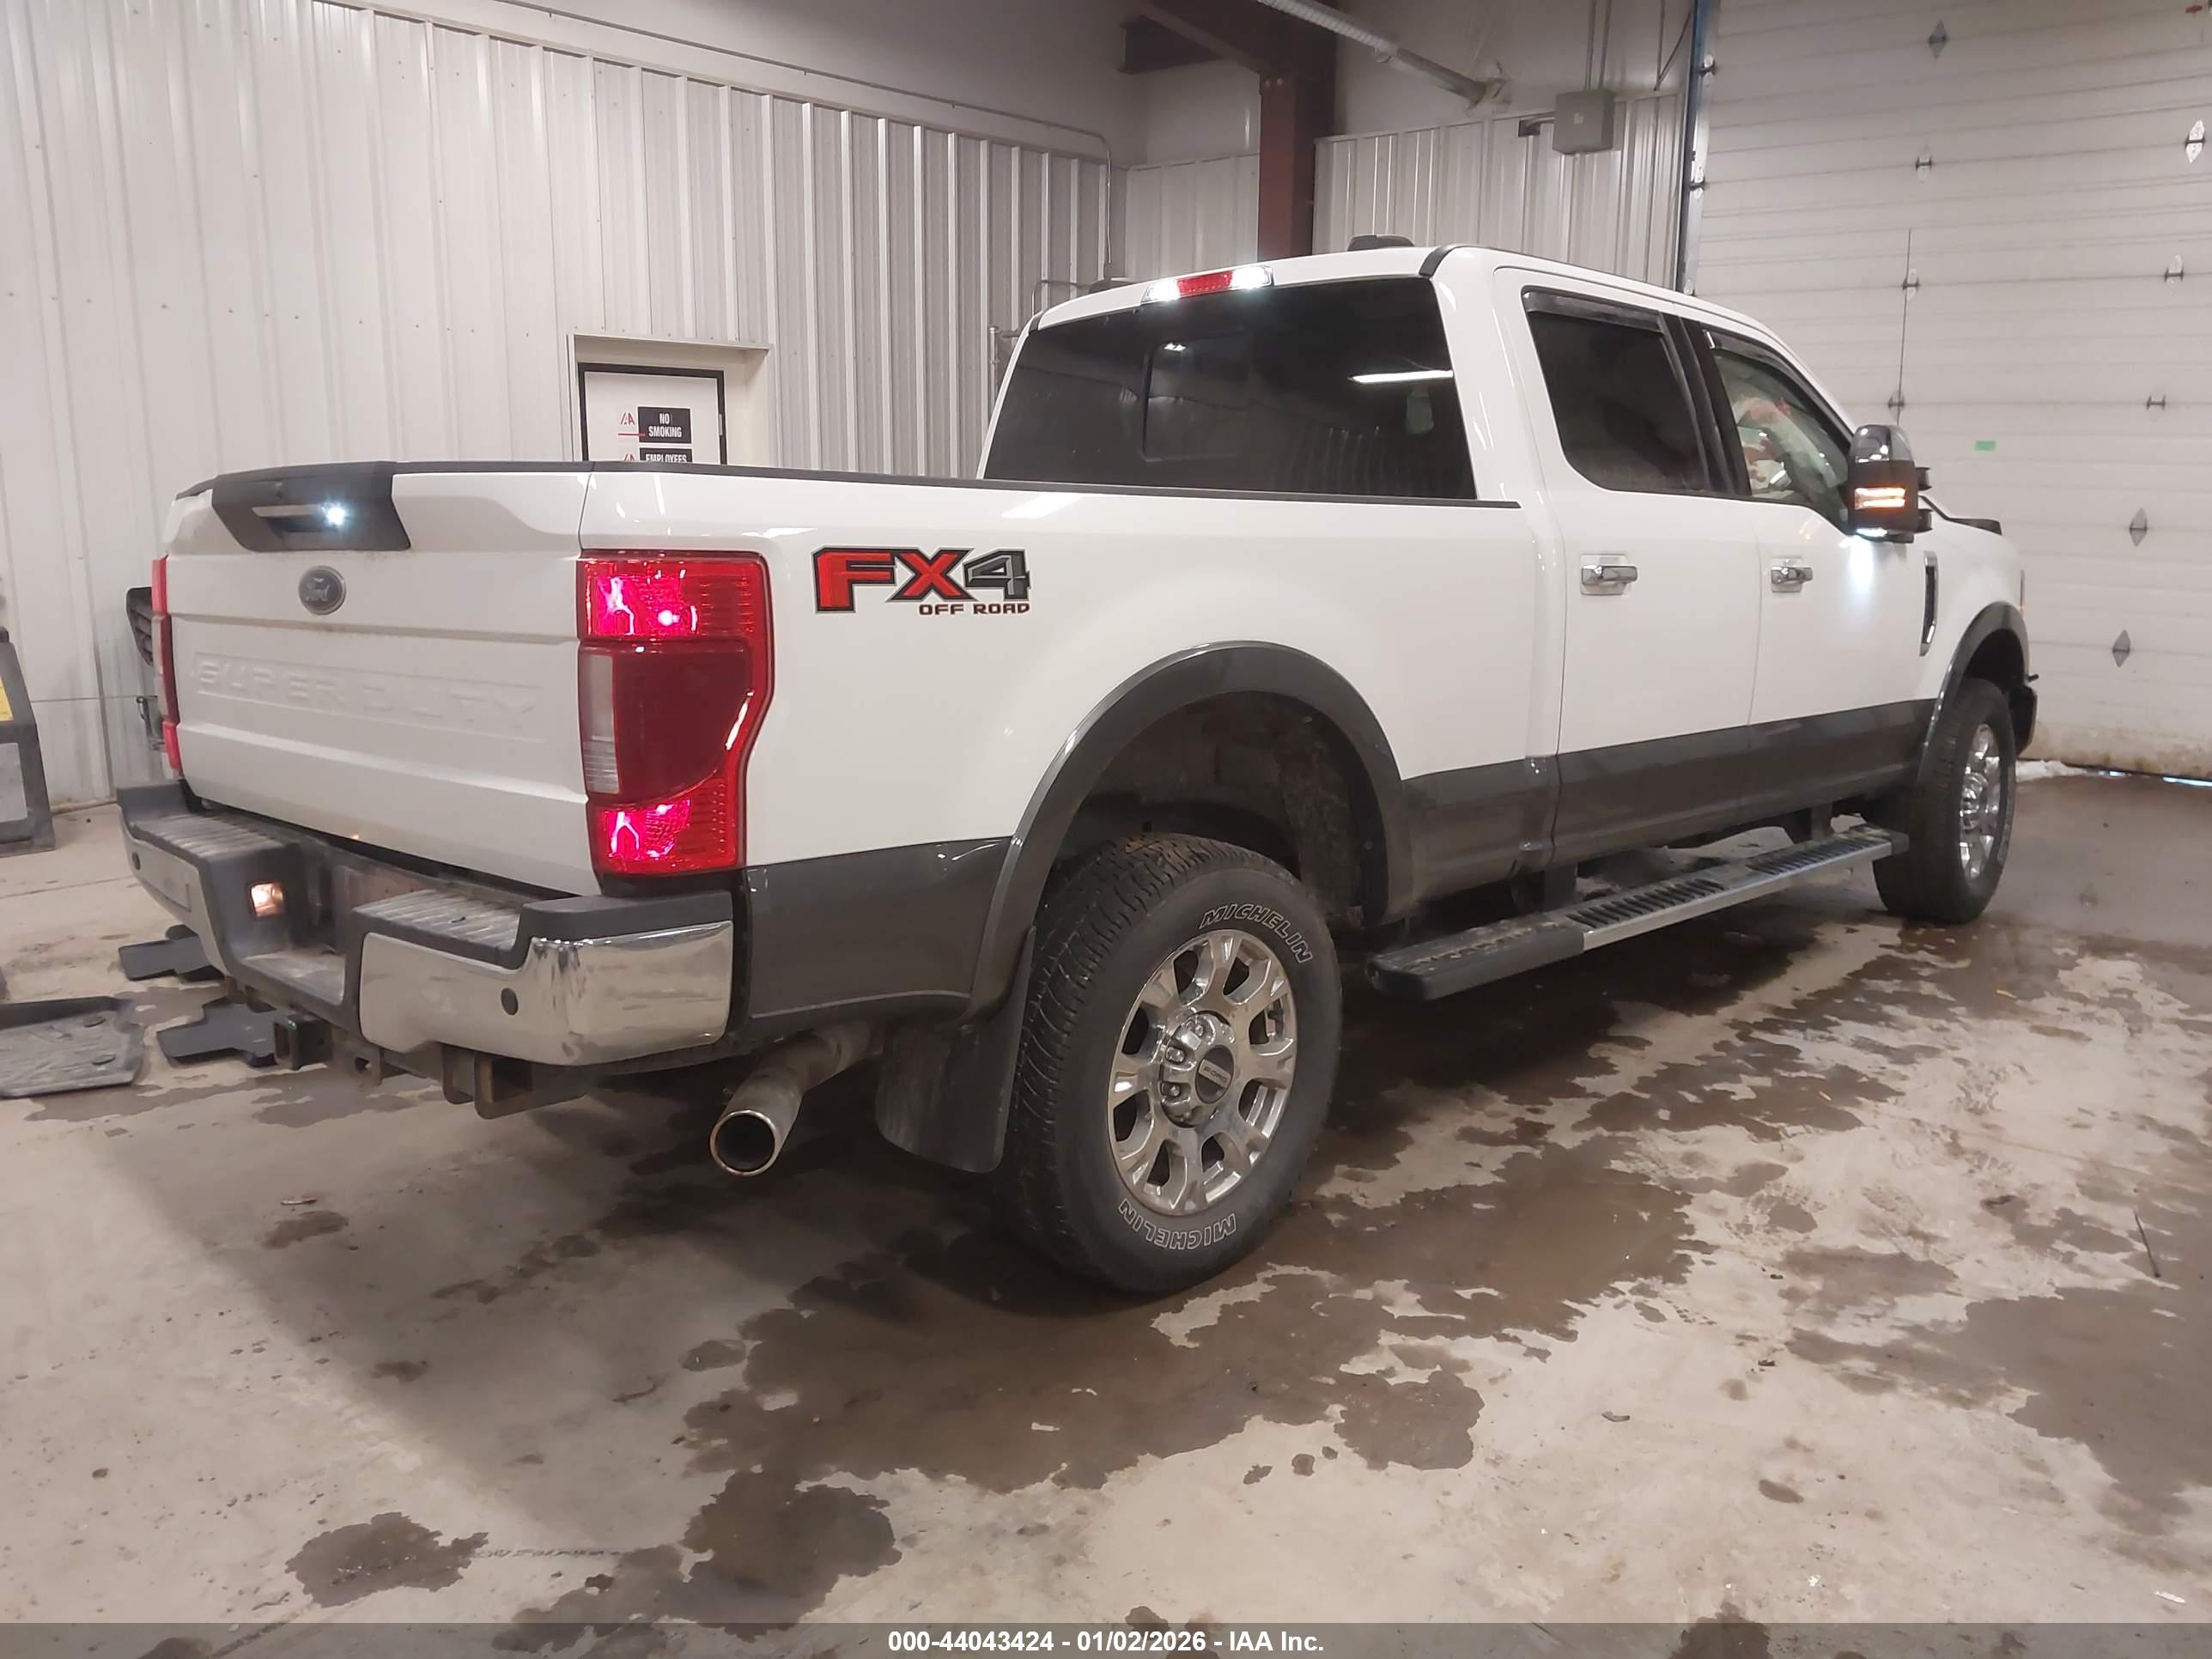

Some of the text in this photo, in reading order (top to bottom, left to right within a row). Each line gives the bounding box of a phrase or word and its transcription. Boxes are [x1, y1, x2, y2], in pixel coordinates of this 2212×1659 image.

[648, 426, 682, 438] SMOKING
[659, 413, 670, 424] NO
[811, 544, 1031, 614] FX4
[919, 602, 1030, 616] OFF ROAD
[1199, 902, 1313, 964] MICHELIN
[1118, 1198, 1237, 1250] MICHELIN
